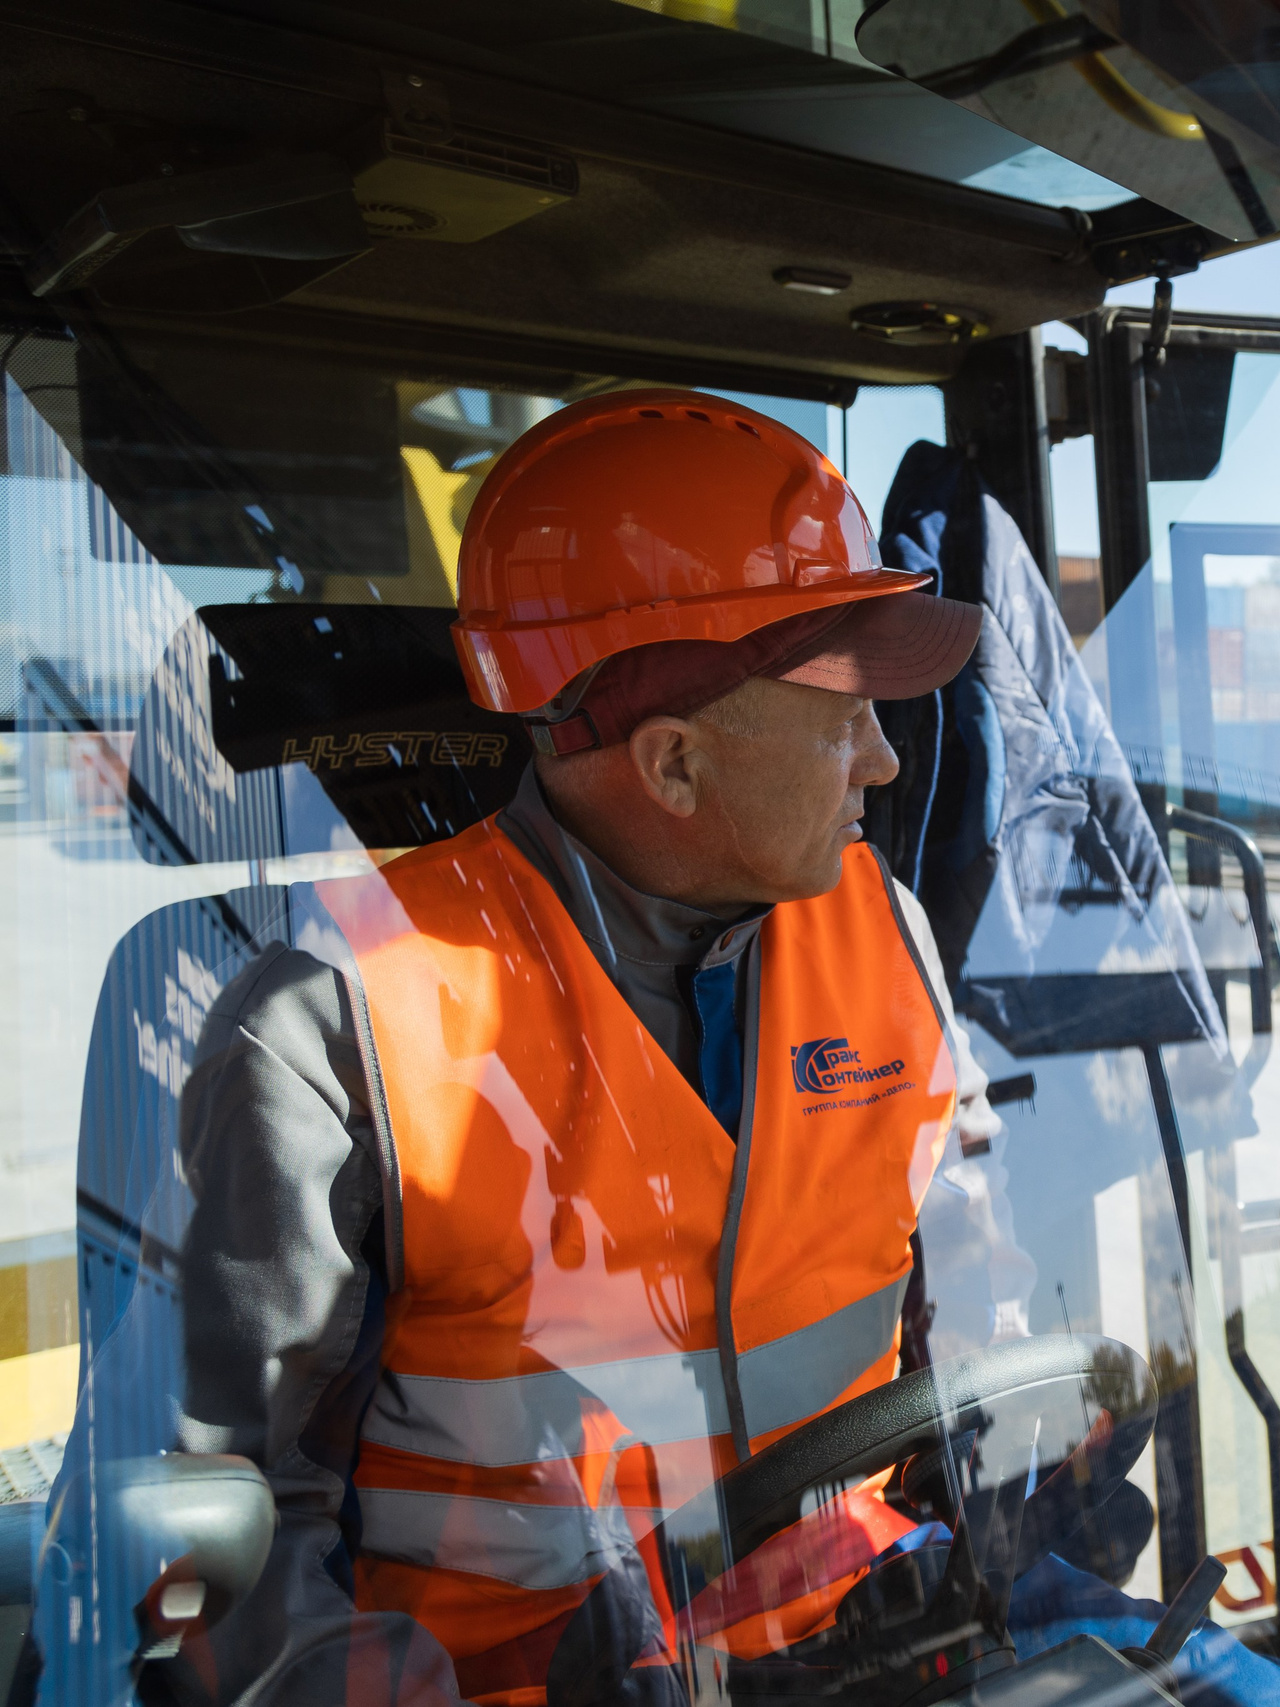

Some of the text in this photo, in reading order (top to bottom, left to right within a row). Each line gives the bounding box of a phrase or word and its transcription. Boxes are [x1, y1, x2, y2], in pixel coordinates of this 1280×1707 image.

[282, 732, 509, 770] HYSTER
[802, 1101, 838, 1116] ГРУППА
[839, 1093, 881, 1109] КОМПАНИЙ
